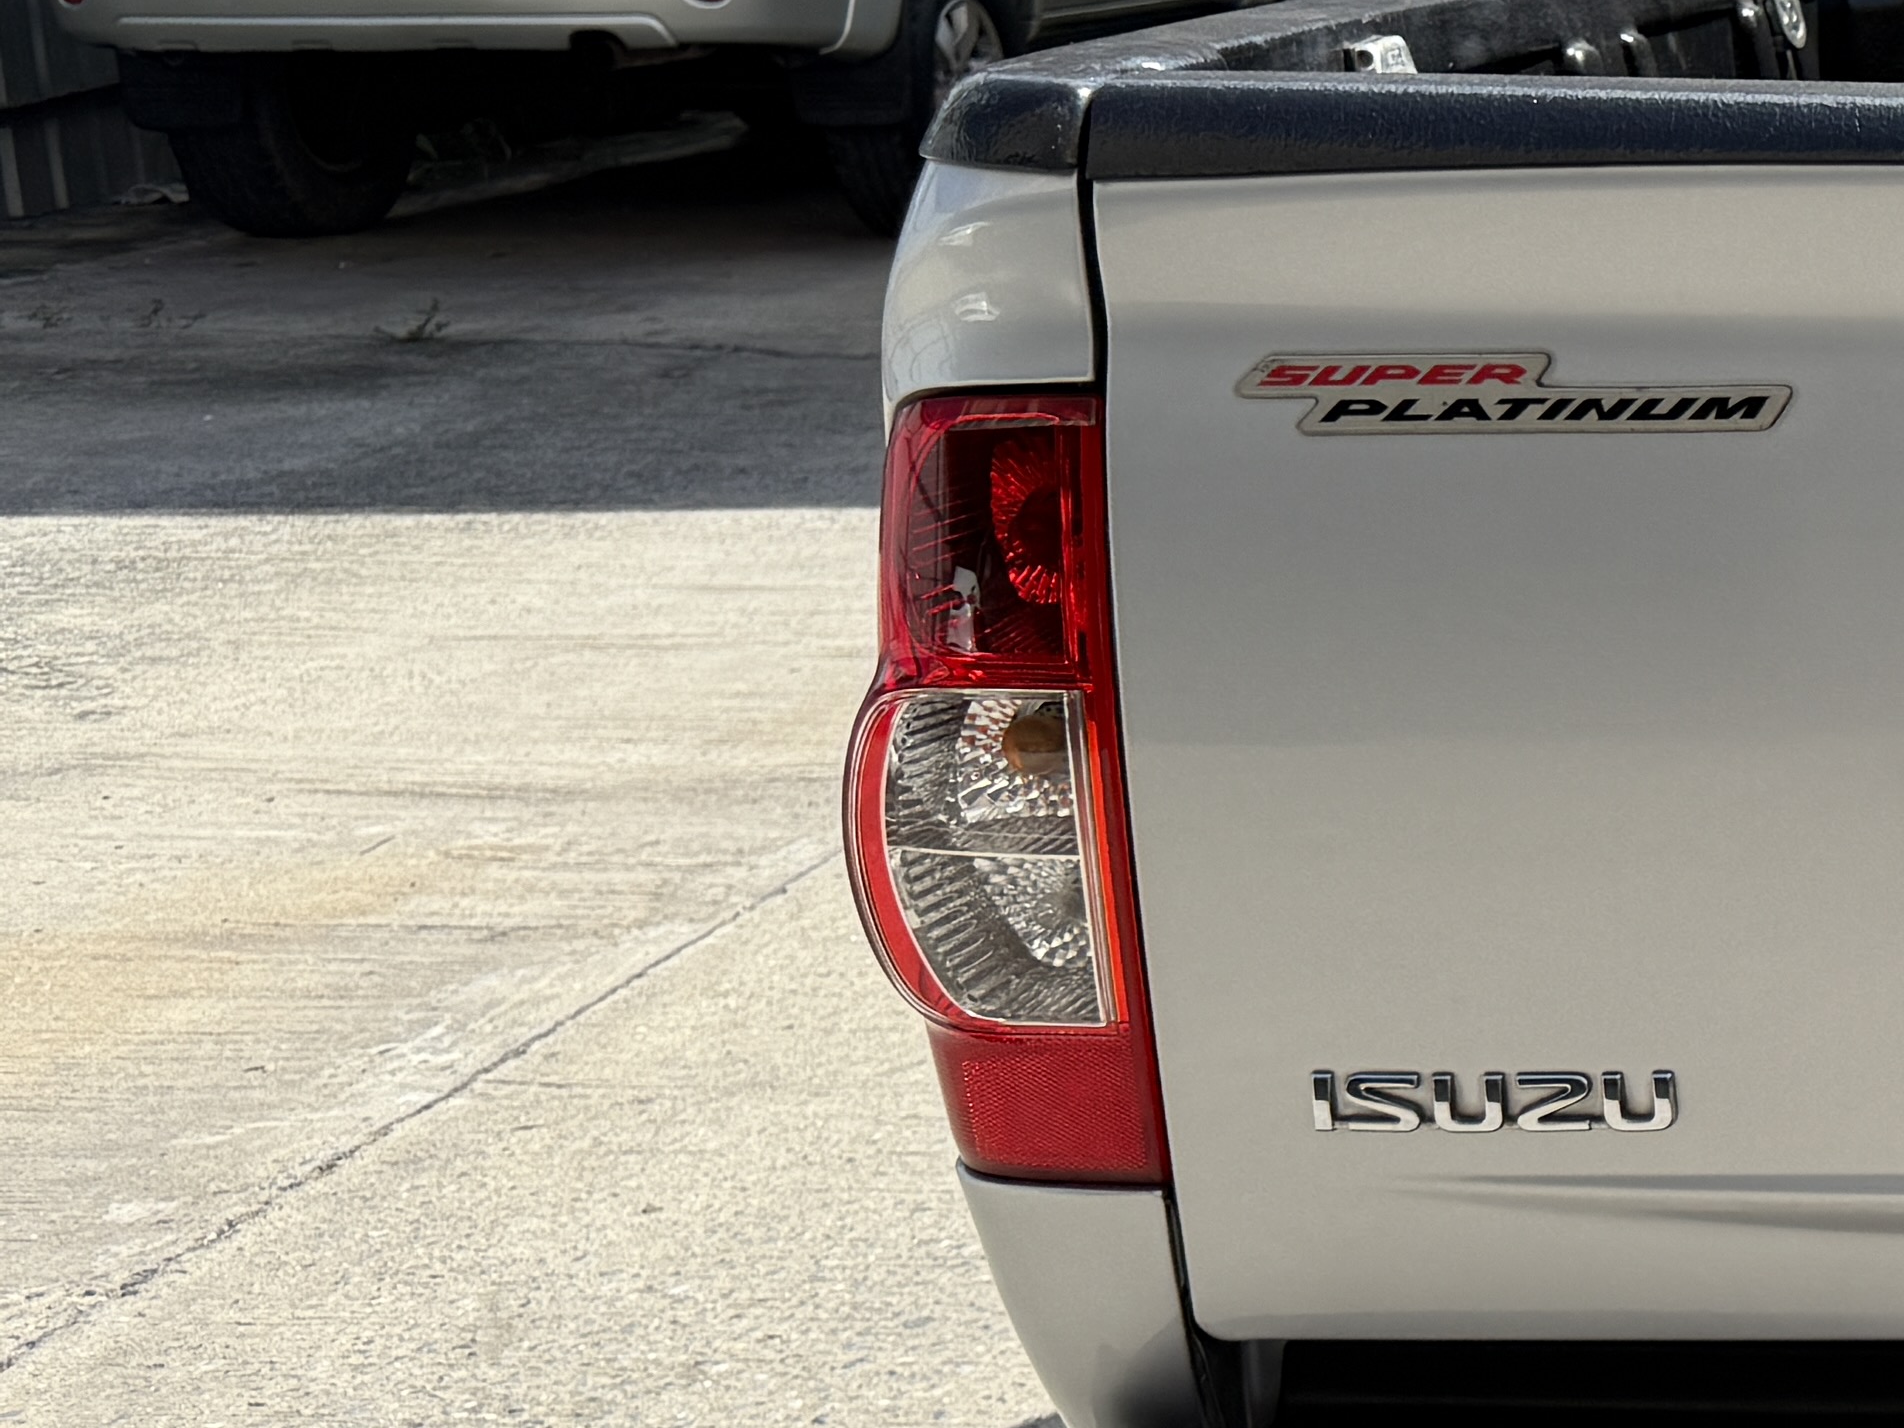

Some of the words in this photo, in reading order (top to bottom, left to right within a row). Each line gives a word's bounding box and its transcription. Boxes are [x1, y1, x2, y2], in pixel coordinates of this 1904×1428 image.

[1258, 363, 1529, 387] SUPER
[1319, 396, 1770, 423] PLATINUM
[1311, 1069, 1679, 1132] ISUZU
